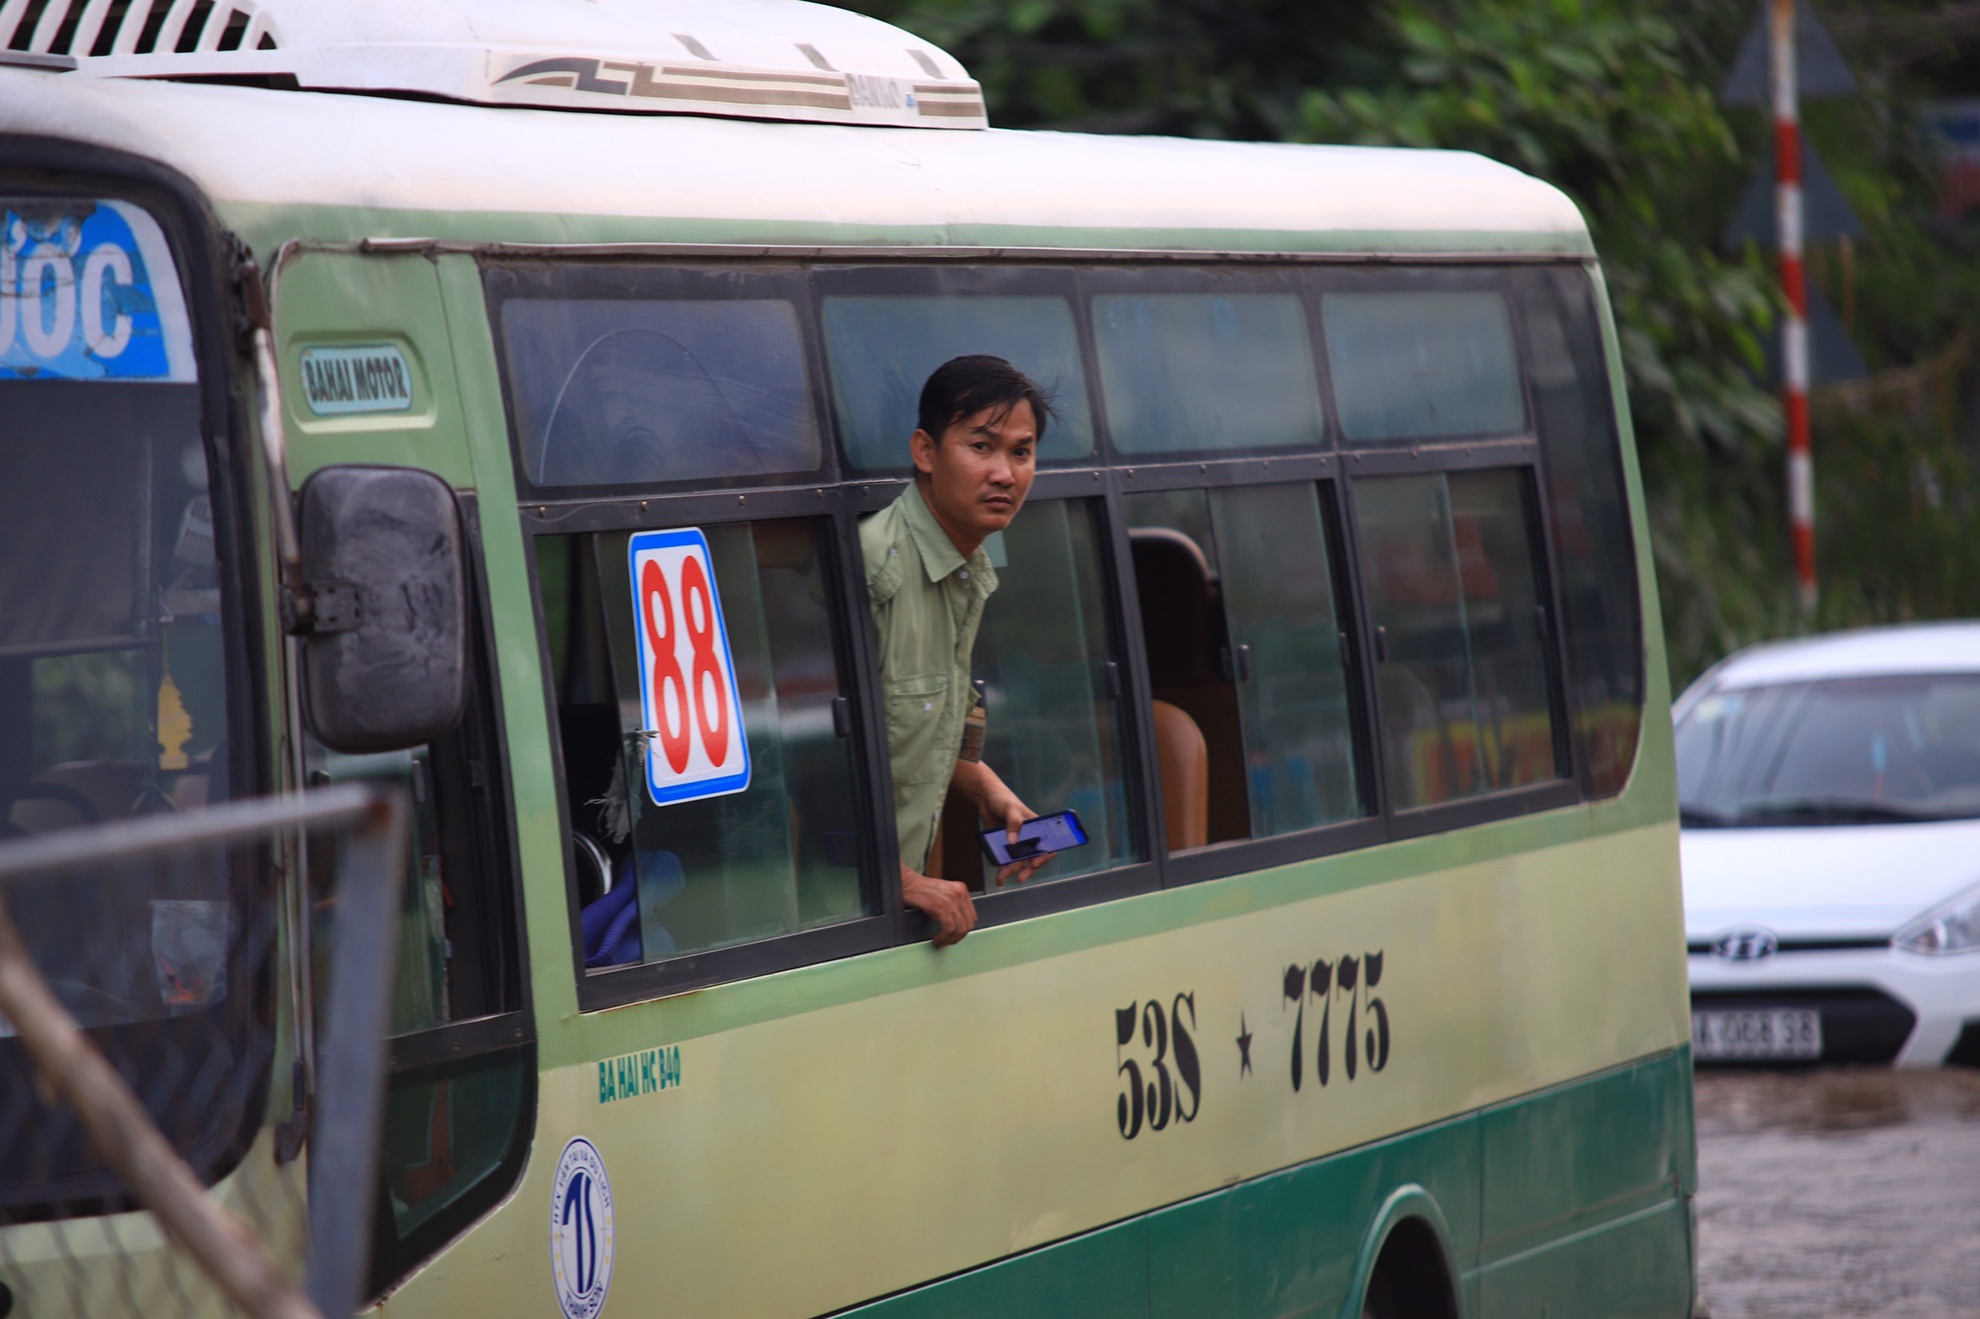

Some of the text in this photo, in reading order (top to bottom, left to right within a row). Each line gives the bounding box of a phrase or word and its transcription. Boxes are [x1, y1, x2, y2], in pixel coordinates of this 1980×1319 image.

[304, 355, 408, 402] BAHAI MOTOR
[642, 555, 729, 774] 88
[599, 1061, 616, 1104] BA
[617, 1054, 639, 1099] HAI
[1115, 949, 1390, 1140] 53S 7775
